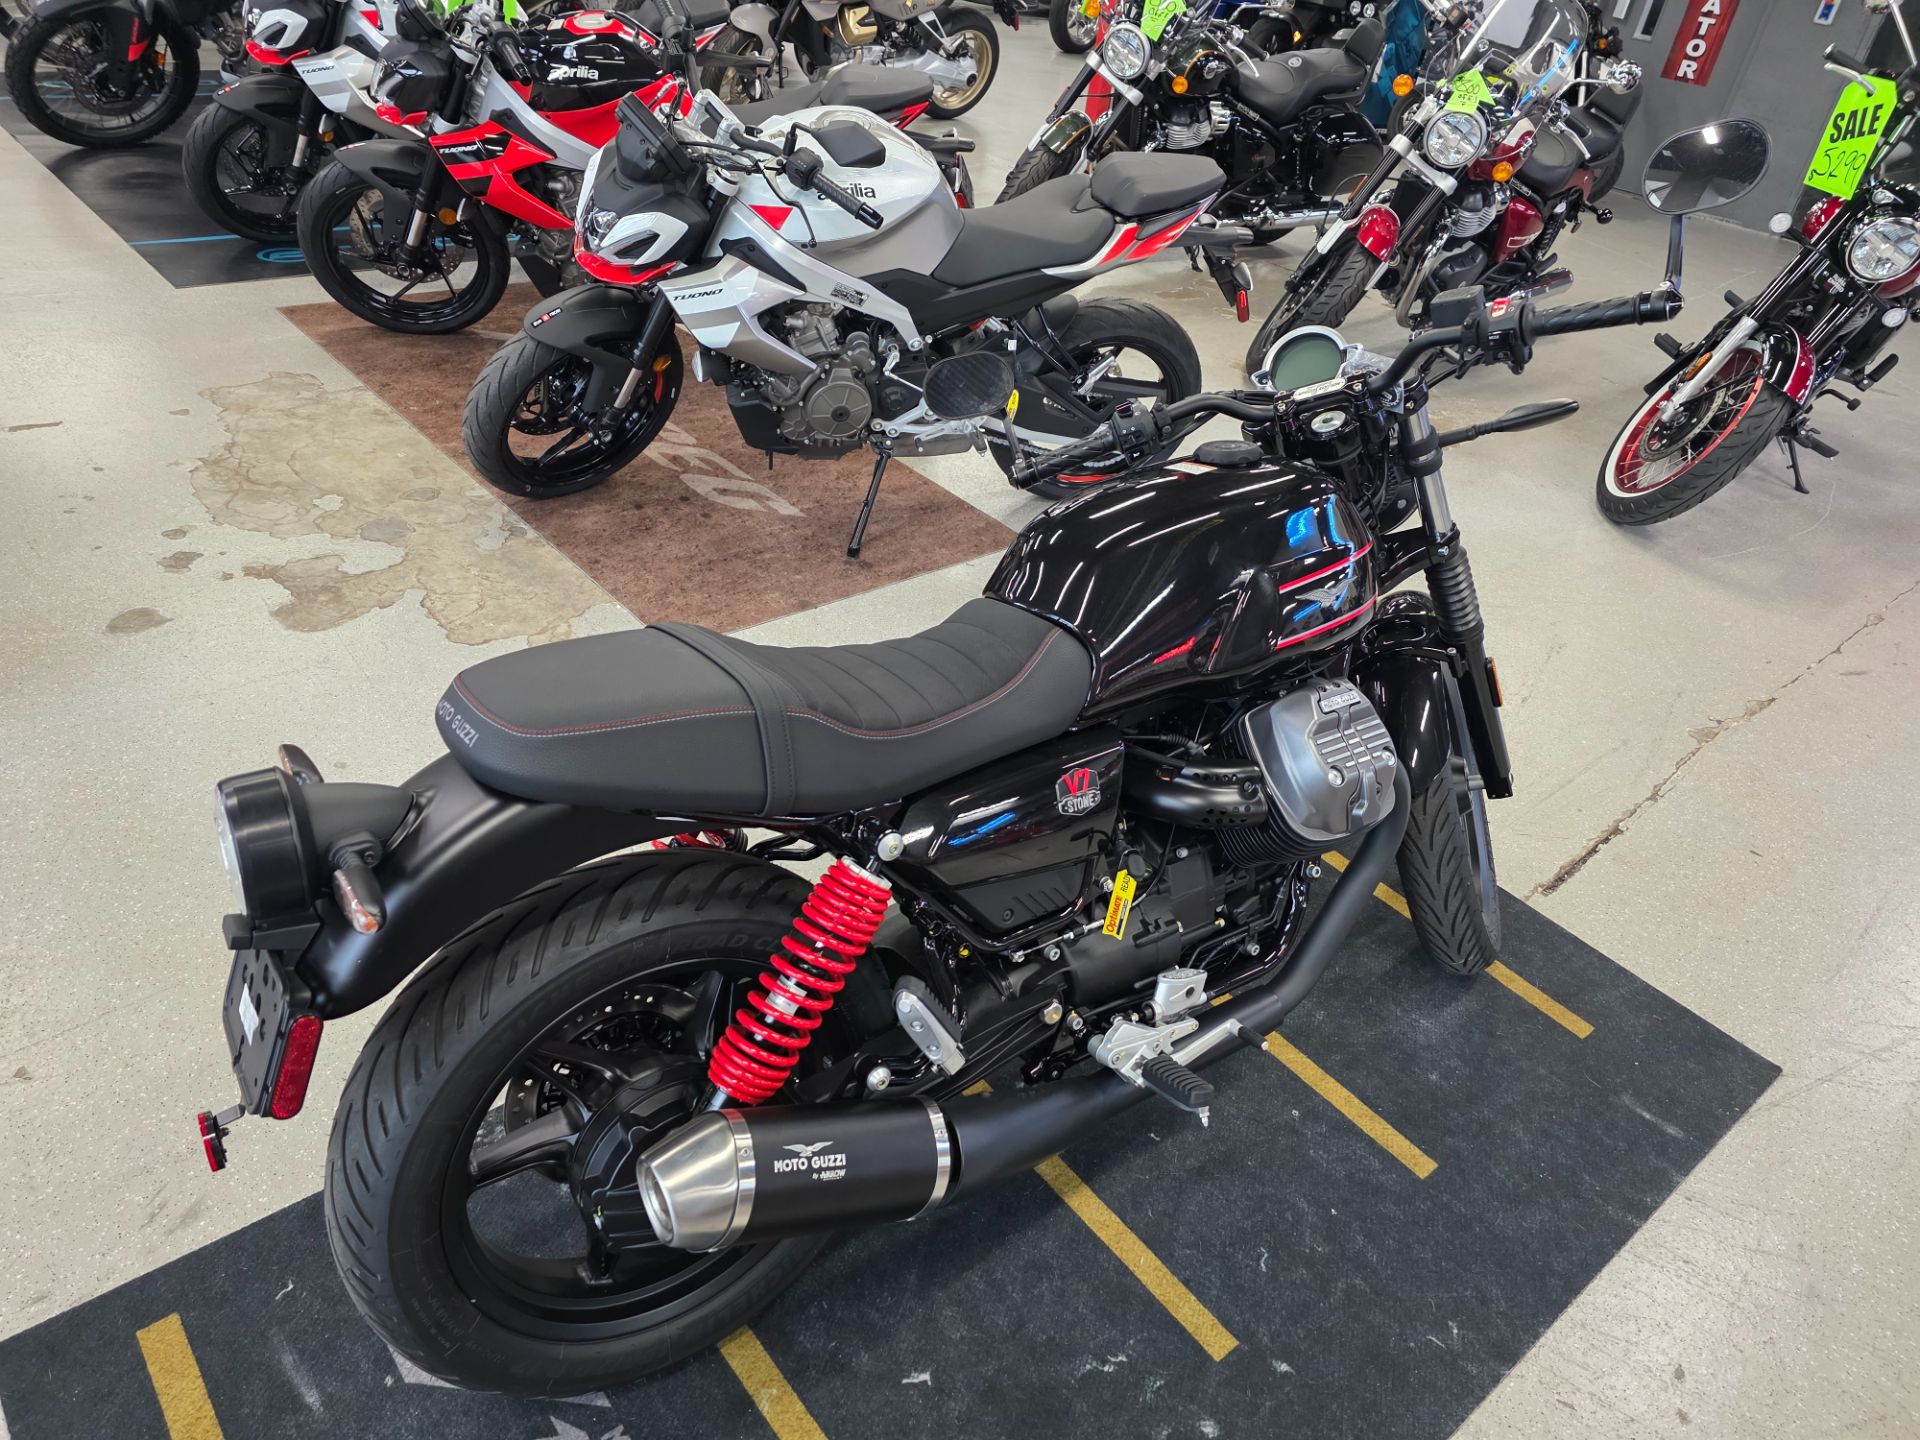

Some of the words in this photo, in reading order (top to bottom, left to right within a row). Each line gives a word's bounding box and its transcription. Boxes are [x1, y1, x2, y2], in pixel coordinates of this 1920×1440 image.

[302, 65, 335, 75] TUONO
[547, 63, 599, 81] aprilia
[1829, 103, 1884, 143] SALE
[439, 144, 478, 154] TUONO
[673, 288, 724, 301] TUONO
[452, 714, 479, 748] GUZZI
[1063, 767, 1090, 797] V7
[774, 1158, 808, 1173] MOTO
[811, 1153, 846, 1168] GUZZI
